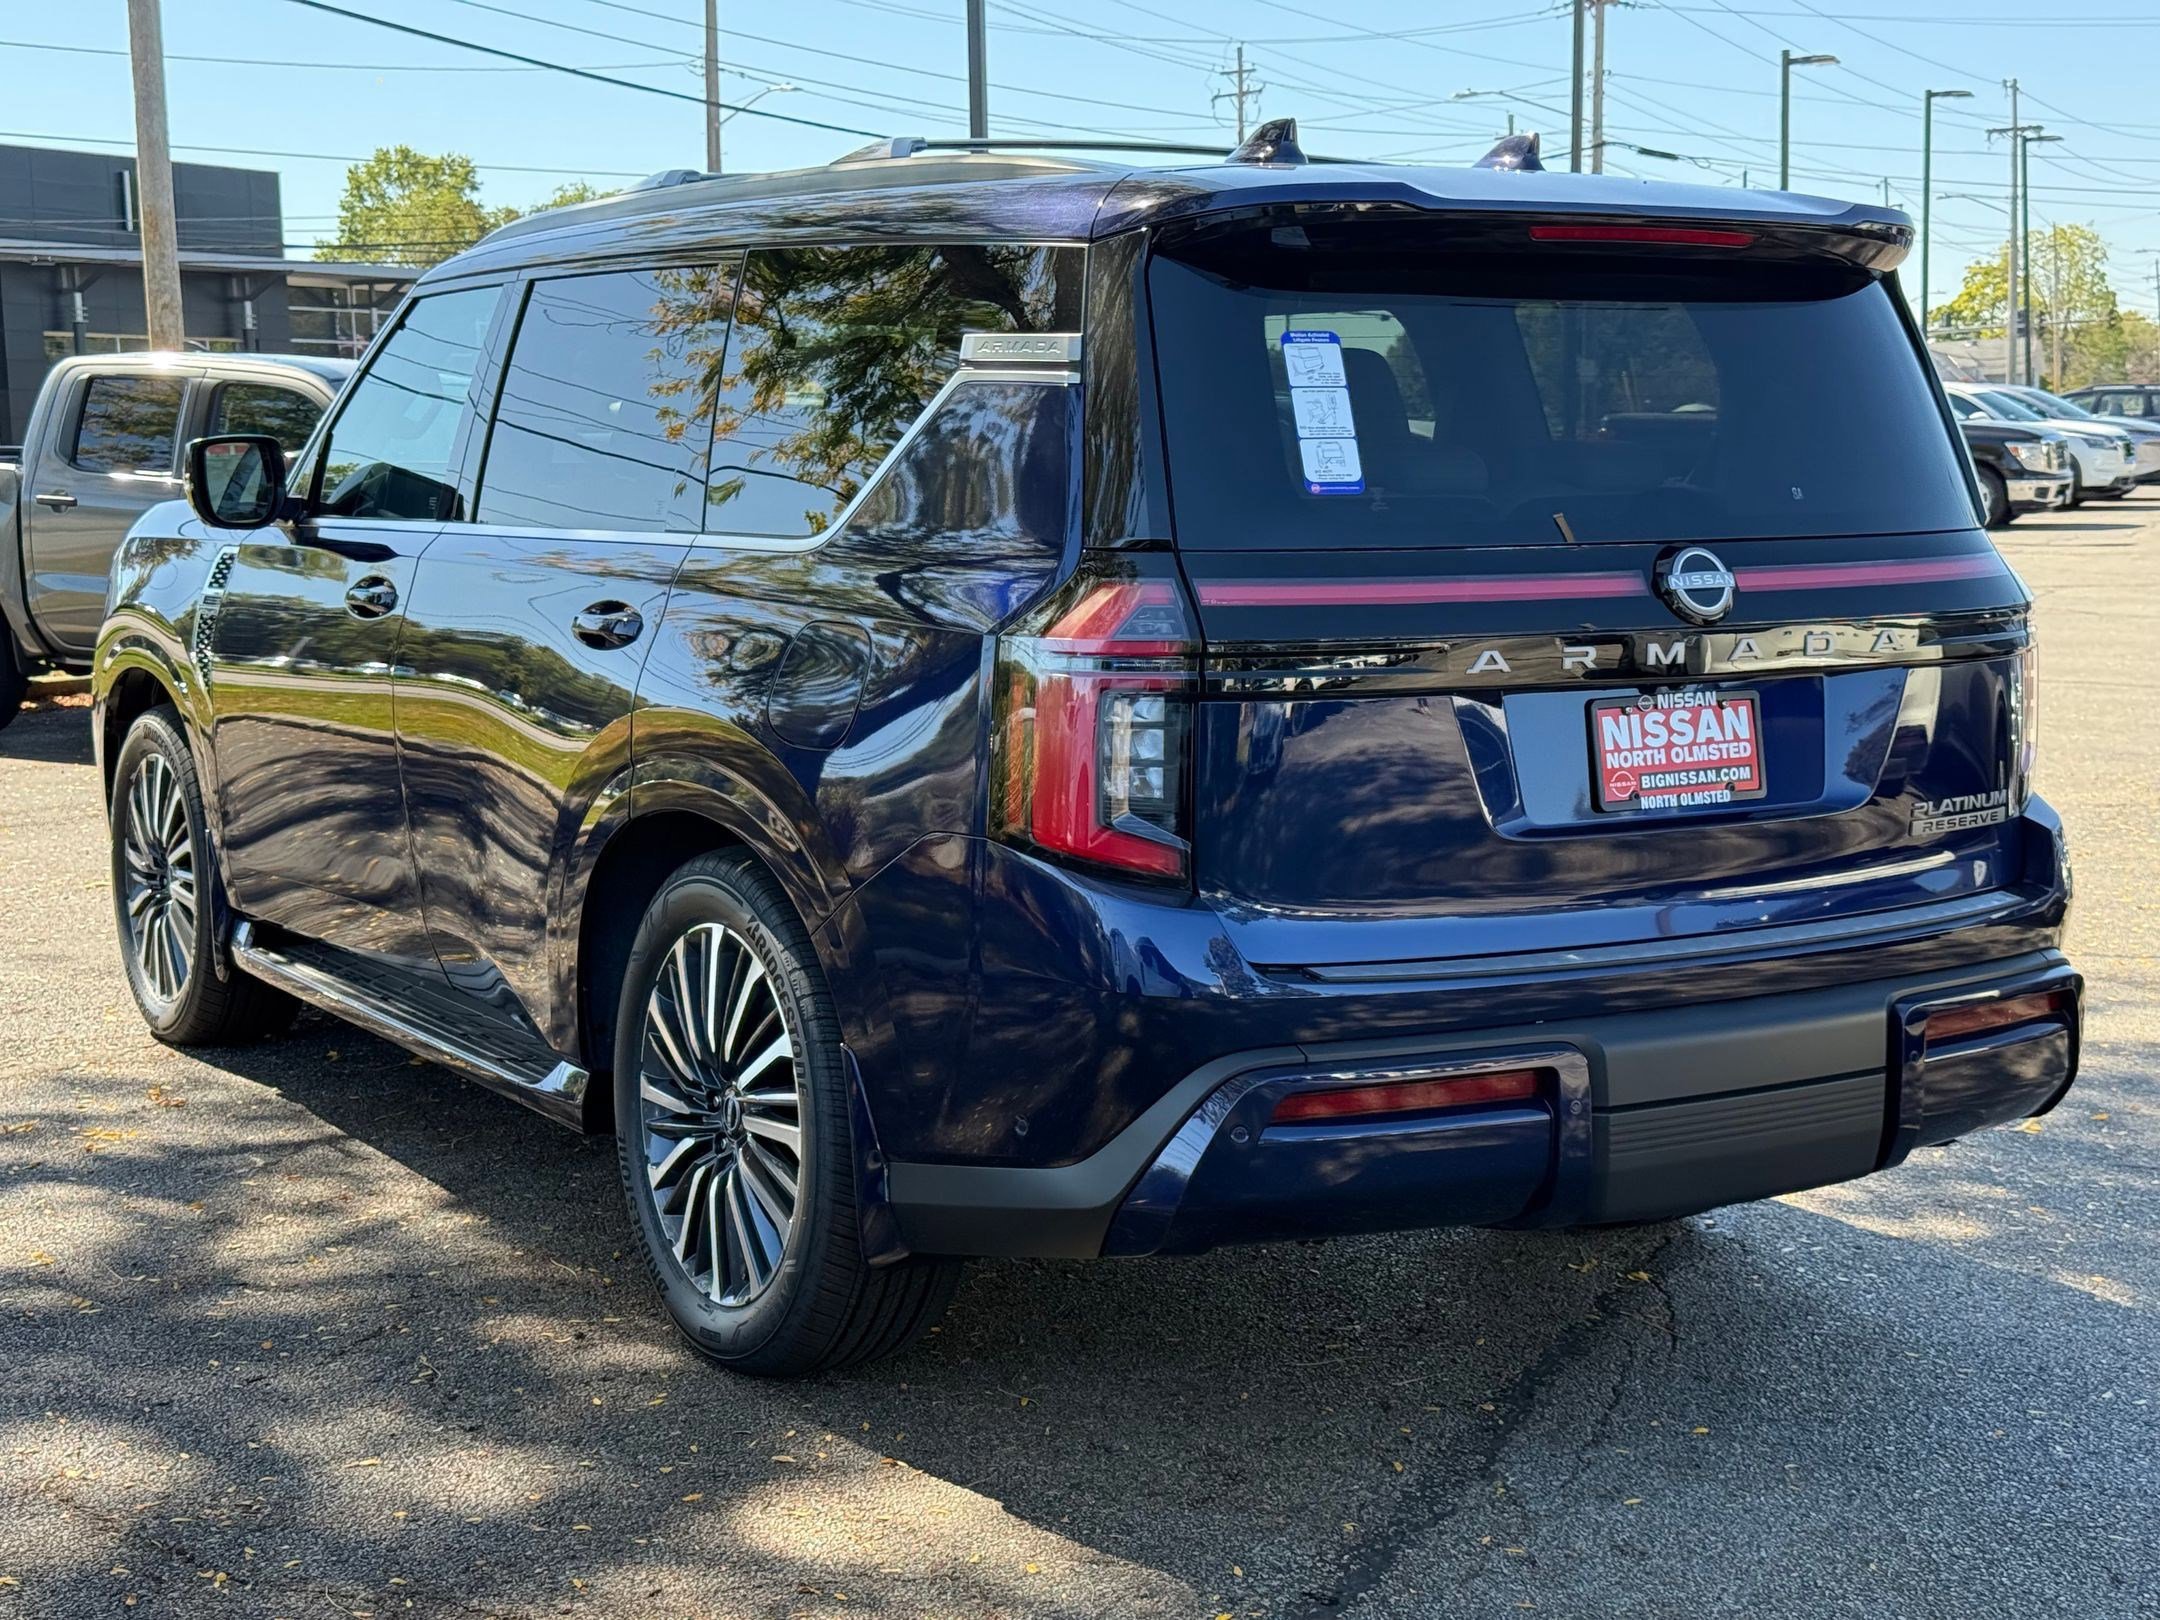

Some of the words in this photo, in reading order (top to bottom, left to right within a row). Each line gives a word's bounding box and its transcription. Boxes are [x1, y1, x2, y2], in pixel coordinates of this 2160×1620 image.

[977, 341, 1061, 353] ARMADA
[1670, 574, 1734, 587] NISSAN
[1465, 629, 1905, 674] ARMADA
[1657, 691, 1716, 709] NISSAN
[1602, 706, 1750, 750] NISSAN
[1606, 748, 1666, 769] NORTH
[1671, 742, 1751, 763] OLMSTED
[1641, 766, 1751, 788] BIGNISSAN.COM
[1641, 793, 1679, 810] NORTH
[1680, 790, 1731, 806] OLMSTED
[1911, 789, 2007, 819] PLATINUM
[1922, 811, 1999, 832] RESERVE
[745, 915, 809, 1099] BRIDGESTONE
